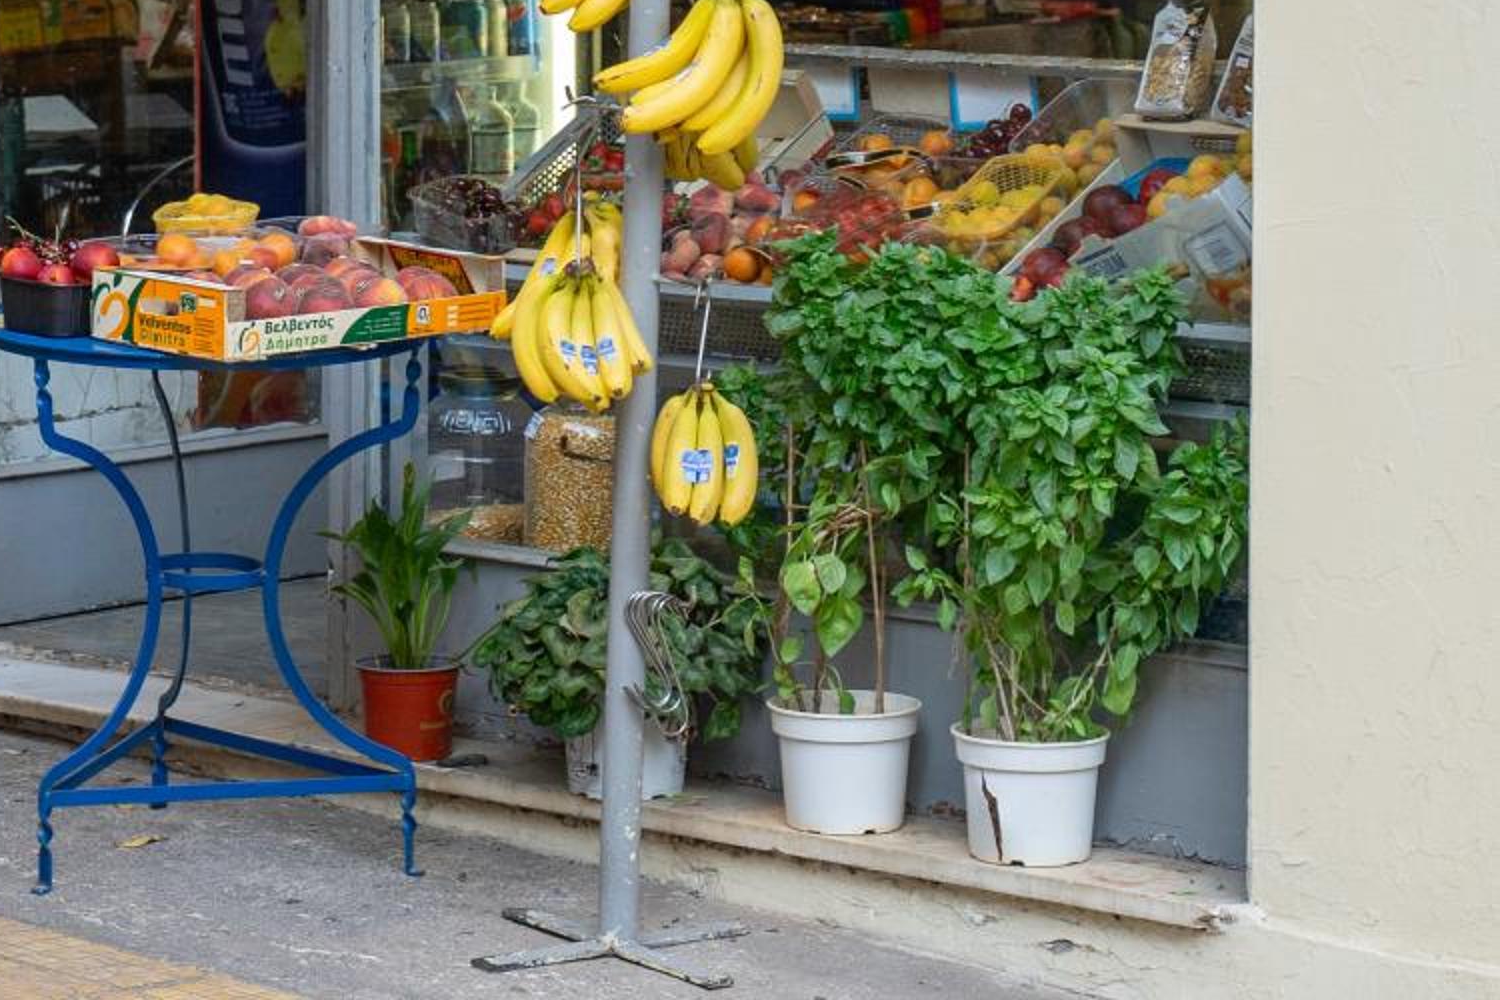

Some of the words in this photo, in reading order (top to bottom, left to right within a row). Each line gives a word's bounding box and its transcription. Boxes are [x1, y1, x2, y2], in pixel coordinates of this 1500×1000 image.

[139, 312, 193, 335] Velventos
[264, 315, 335, 335] Βελβεντός
[265, 334, 329, 350] Δήμητρα
